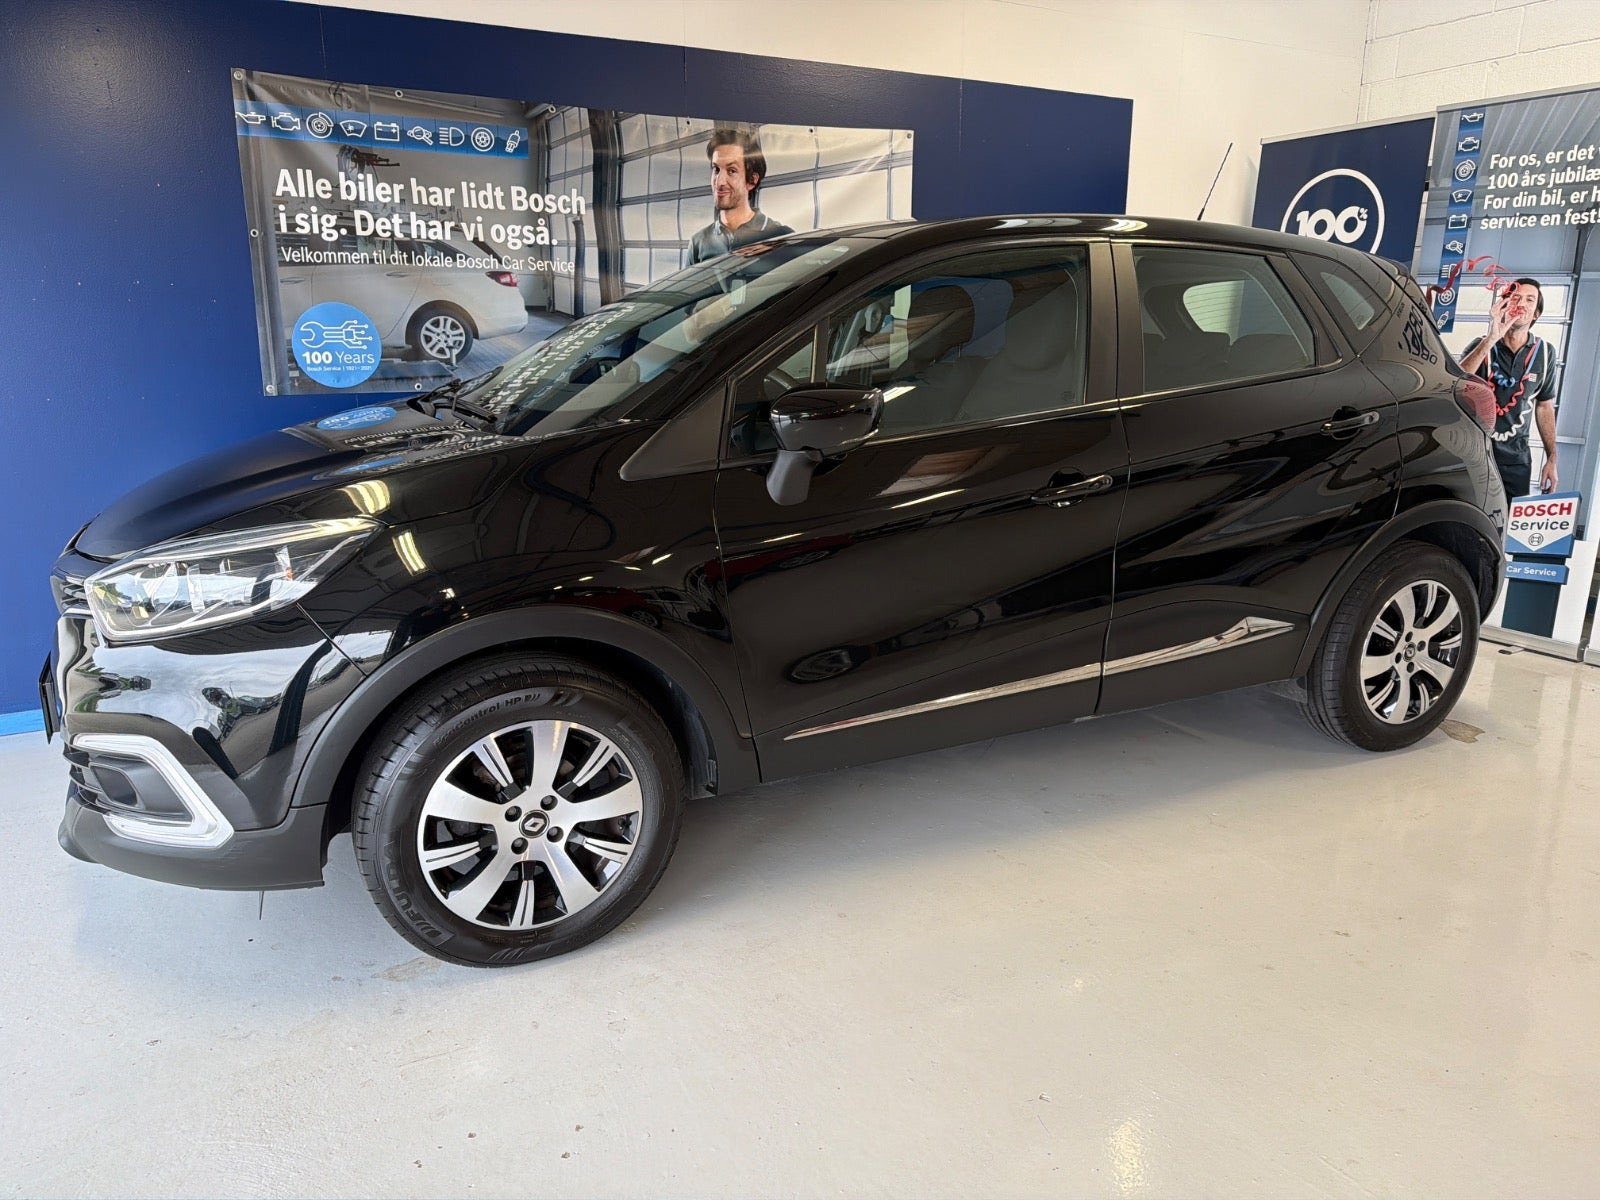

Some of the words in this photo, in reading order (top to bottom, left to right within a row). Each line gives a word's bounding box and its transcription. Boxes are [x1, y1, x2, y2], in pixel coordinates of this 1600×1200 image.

[1490, 153, 1517, 170] For
[1519, 153, 1541, 167] os,
[1545, 150, 1564, 164] er
[1566, 144, 1595, 162] det
[1487, 172, 1519, 190] 100
[1521, 170, 1546, 187] års
[275, 168, 333, 199] Alle
[339, 171, 404, 203] biler
[410, 177, 455, 207] har
[460, 181, 506, 211] lidt
[510, 185, 587, 215] Bosch
[1483, 194, 1510, 210] For
[1512, 191, 1537, 208] din
[1540, 189, 1566, 207] bil,
[1570, 190, 1589, 204] er
[278, 205, 288, 233] i
[295, 207, 348, 242] sig.
[354, 209, 405, 239] Det
[410, 212, 455, 242] har
[460, 216, 485, 242] vi
[490, 218, 558, 250] også.
[1480, 212, 1537, 230] service
[1540, 213, 1561, 226] en
[281, 246, 369, 266] Velkommen
[372, 250, 388, 266] til
[389, 251, 409, 267] dit
[412, 252, 453, 269] lokale
[456, 254, 499, 270] Bosch
[502, 256, 525, 271] Car
[528, 258, 576, 273] Service
[302, 351, 333, 364] 100
[335, 351, 375, 364] Years
[1512, 502, 1573, 518] BOSCH
[1510, 519, 1570, 531] Service
[1506, 565, 1521, 574] Car
[1523, 567, 1557, 577] Service
